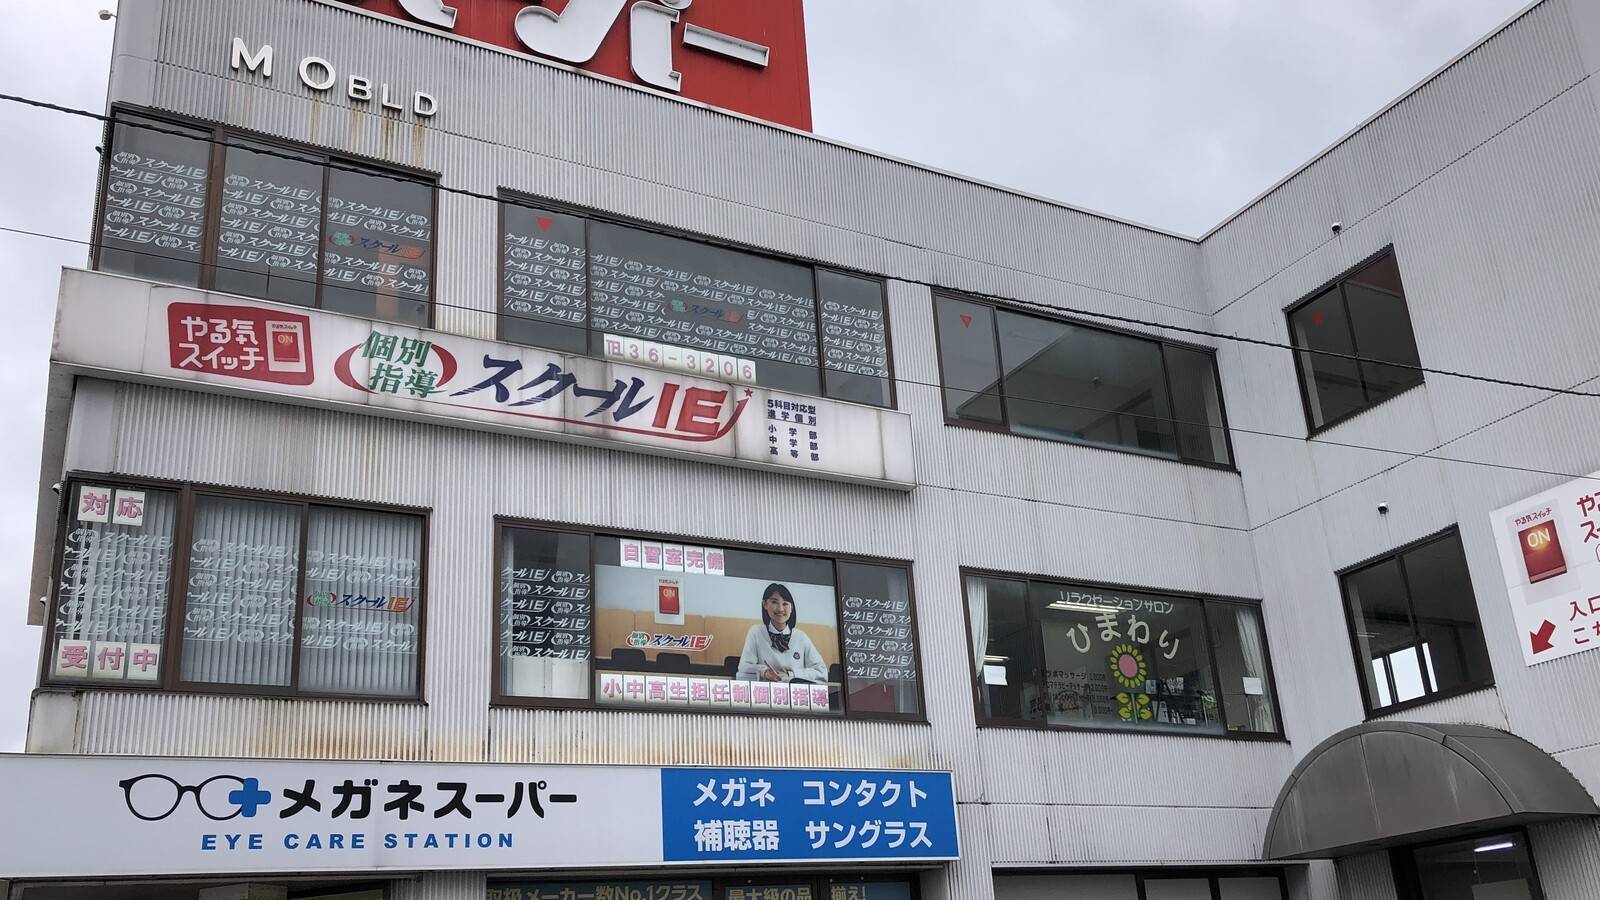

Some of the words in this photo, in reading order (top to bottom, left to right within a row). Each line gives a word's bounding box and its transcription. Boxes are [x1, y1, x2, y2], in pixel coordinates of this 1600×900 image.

[181, 316, 259, 344] やる気
[278, 335, 293, 344] ON
[178, 343, 264, 370] スイッチ
[361, 330, 432, 367] 個別
[629, 343, 752, 379] 36-3206
[369, 362, 447, 398] 指導
[82, 493, 143, 518] 対応
[1515, 507, 1552, 526] やる気スイッチ
[1527, 528, 1551, 548] ON
[1580, 520, 1600, 543] ス
[623, 544, 724, 570] 自習室完備
[1060, 591, 1174, 614] リラクゼーションサロン
[1066, 613, 1179, 660] ひまわり
[61, 645, 158, 672] 受付中
[603, 679, 828, 706] 小中高生担任制個別指導
[279, 779, 578, 820] メガネスーパー
[693, 777, 775, 807] メガネ
[802, 779, 927, 808] コンタクト
[201, 834, 263, 851] EYE
[283, 833, 366, 849] CARE
[384, 833, 514, 849] STATION
[694, 820, 779, 851] 補聴器
[805, 820, 933, 849] サングラス
